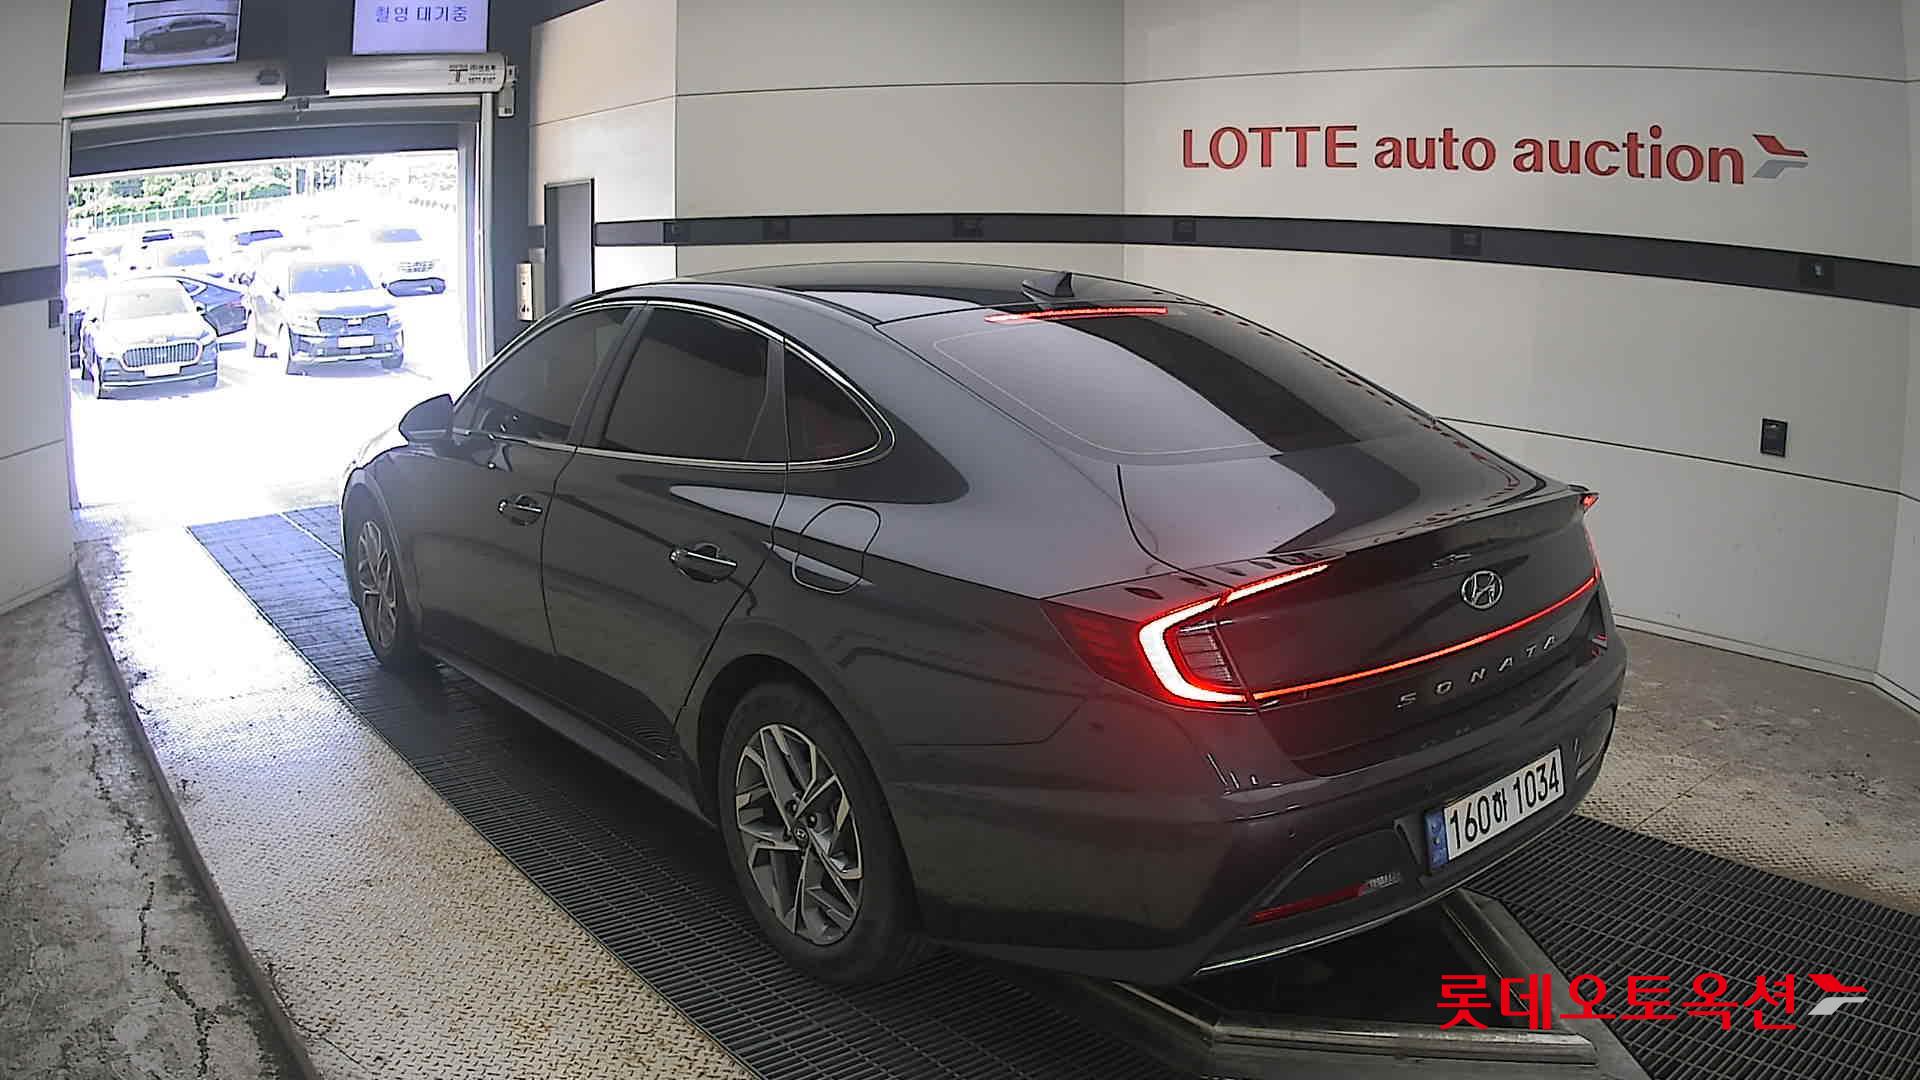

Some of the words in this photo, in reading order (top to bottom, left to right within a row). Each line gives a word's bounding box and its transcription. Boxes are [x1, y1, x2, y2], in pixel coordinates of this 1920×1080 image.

[416, 6, 467, 22] 대기중
[1183, 125, 1357, 169] LOTTE
[1374, 127, 1496, 172] auto
[1513, 125, 1744, 184] auction
[1397, 635, 1556, 709] SONATA
[1513, 757, 1560, 814] 1034
